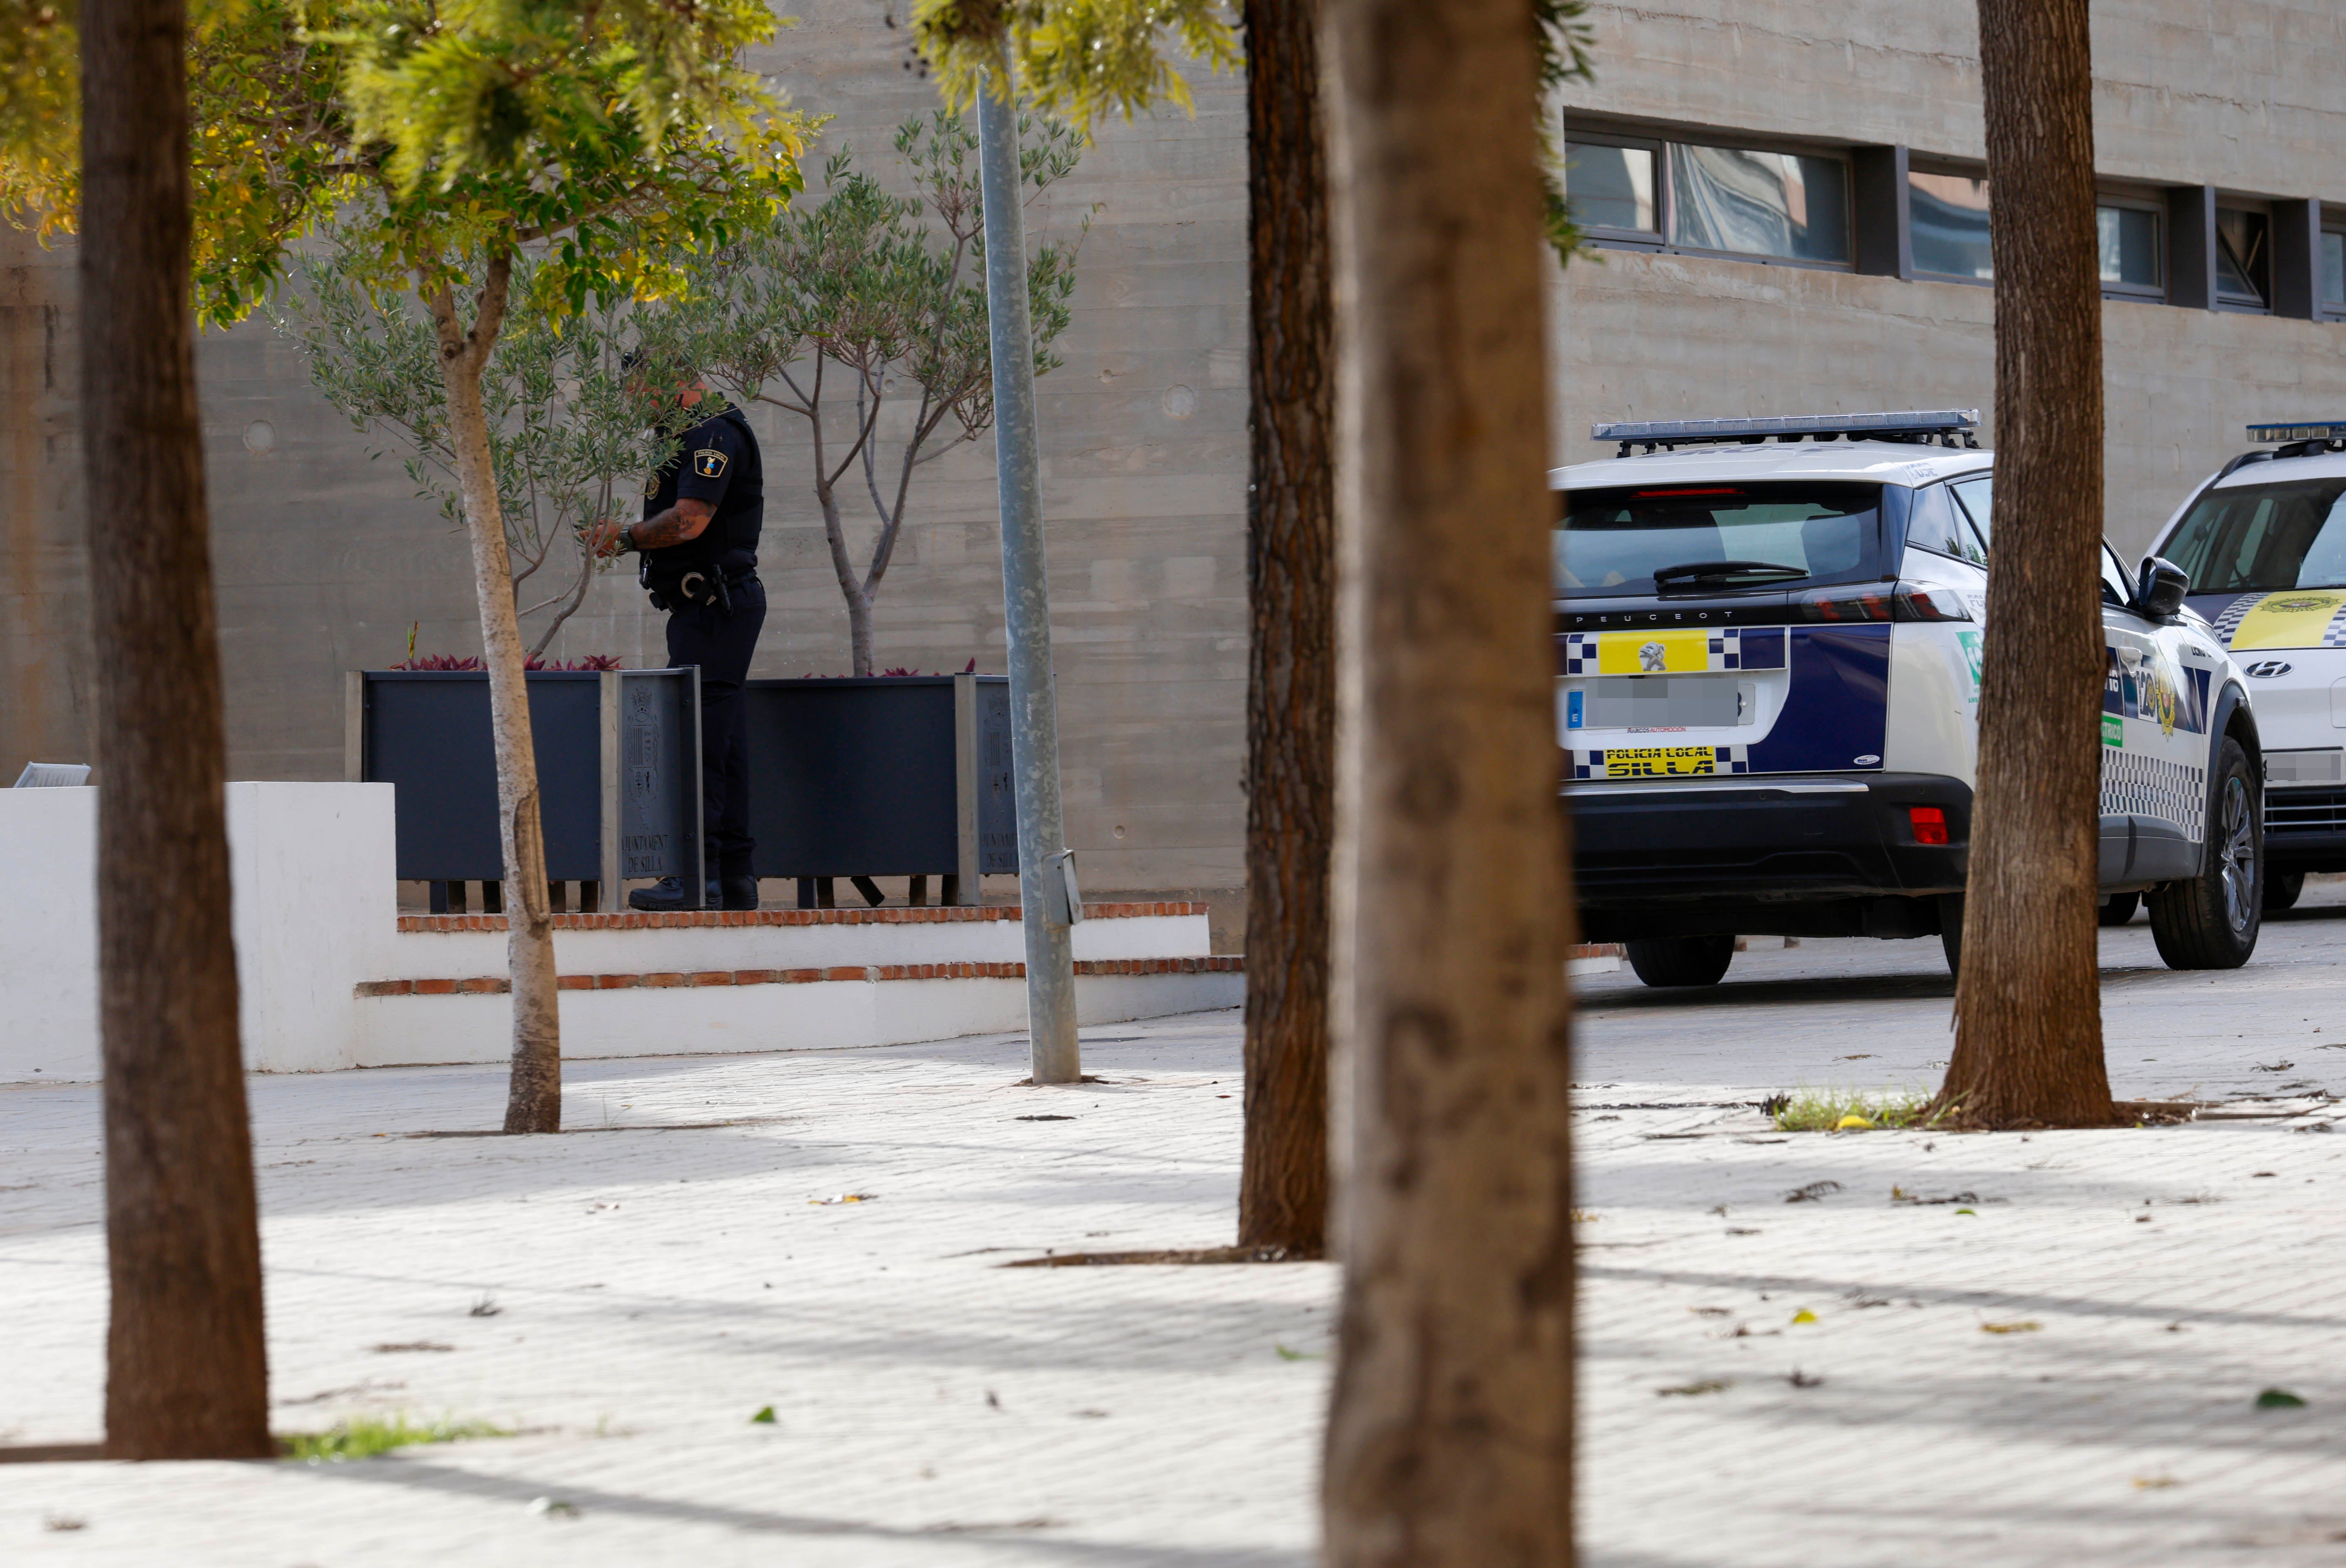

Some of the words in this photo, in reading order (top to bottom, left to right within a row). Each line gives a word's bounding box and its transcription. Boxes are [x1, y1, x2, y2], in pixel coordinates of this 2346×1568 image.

[1576, 611, 1732, 623] PEUGEOT
[1572, 714, 1578, 722] E
[1607, 748, 1661, 759] POLICIA
[1666, 746, 1713, 758] LOCAL
[1608, 760, 1714, 776] SILLA
[628, 857, 638, 872] DE
[641, 856, 662, 872] SILLA
